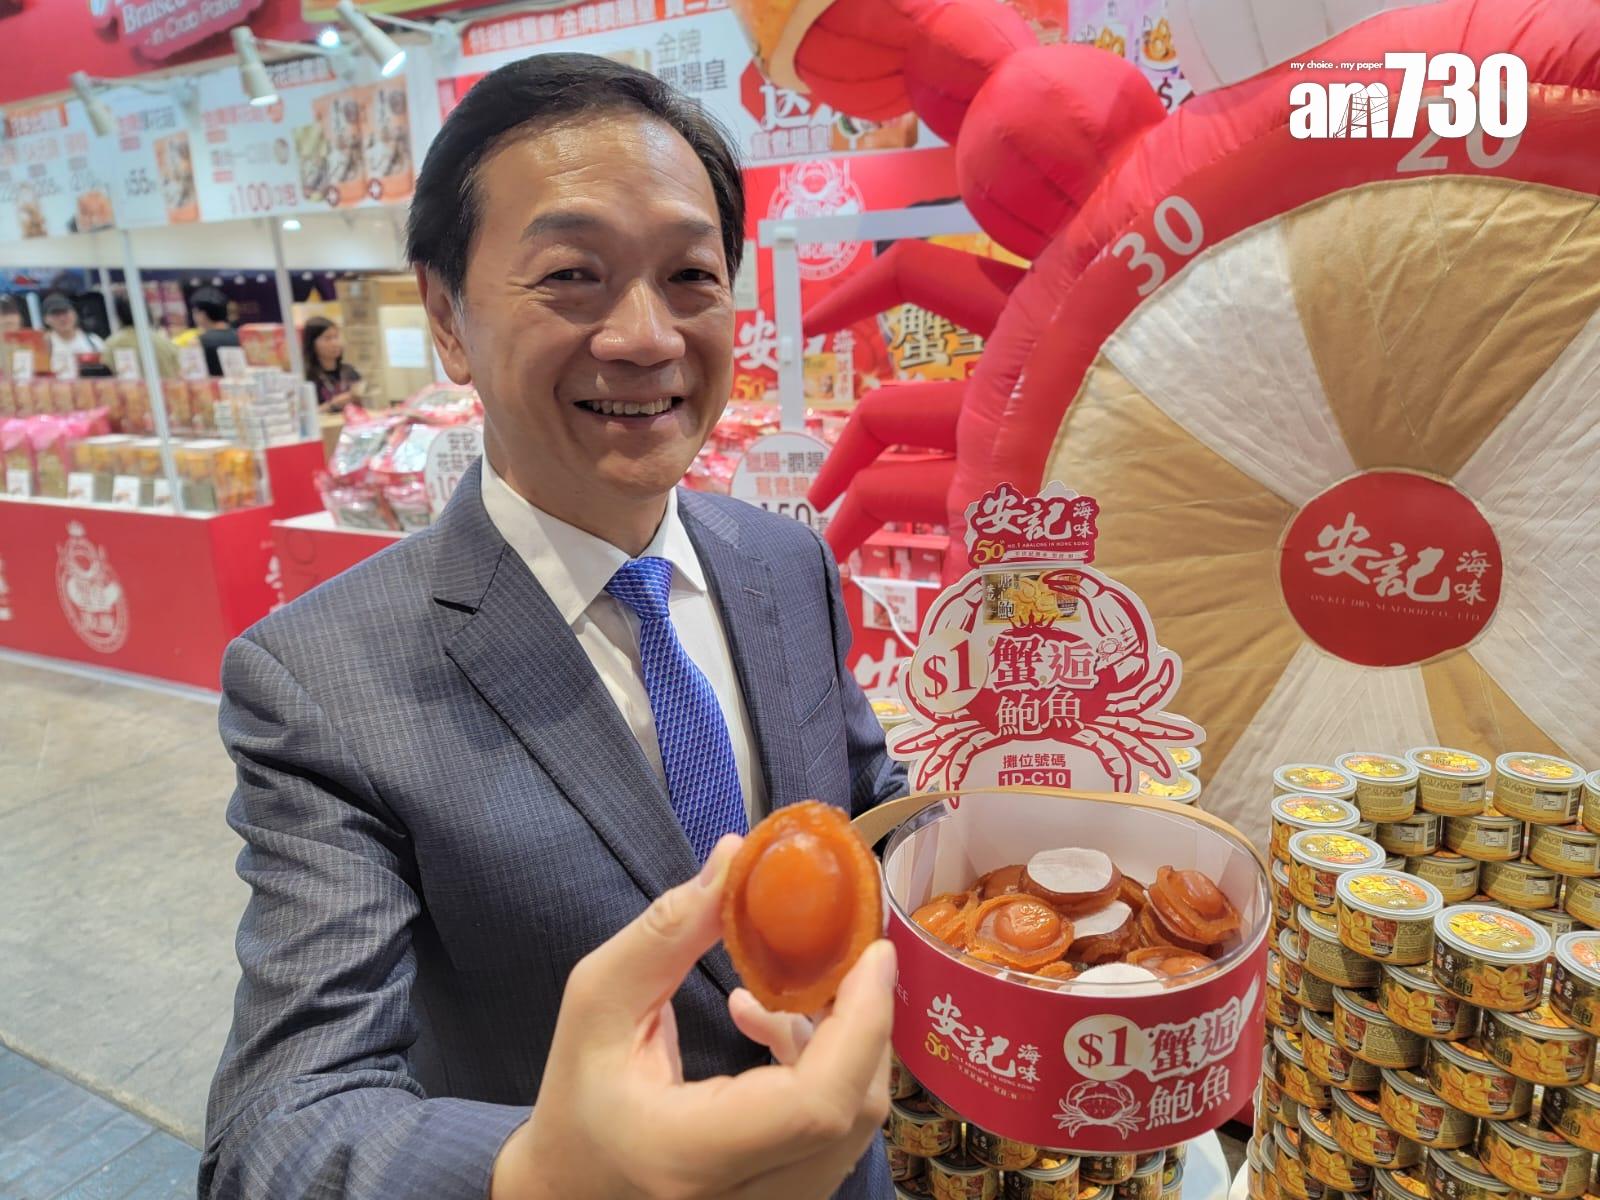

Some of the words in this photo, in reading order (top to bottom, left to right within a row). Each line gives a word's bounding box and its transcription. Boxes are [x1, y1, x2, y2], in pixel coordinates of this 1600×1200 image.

[1112, 196, 1204, 298] 30
[976, 486, 1072, 541] 安記
[1073, 501, 1095, 539] 海味
[1304, 512, 1450, 603] 安記
[1454, 550, 1492, 606] 海味
[923, 639, 977, 699] $1
[995, 686, 1086, 735] 鮑魚
[1002, 771, 1067, 786] 1D-C10
[1003, 753, 1067, 769] 攤位號碼
[926, 993, 1016, 1078] 安記
[1017, 1044, 1042, 1083] 海味
[1077, 1026, 1132, 1069] $1
[1145, 1064, 1231, 1131] 鮑魚
